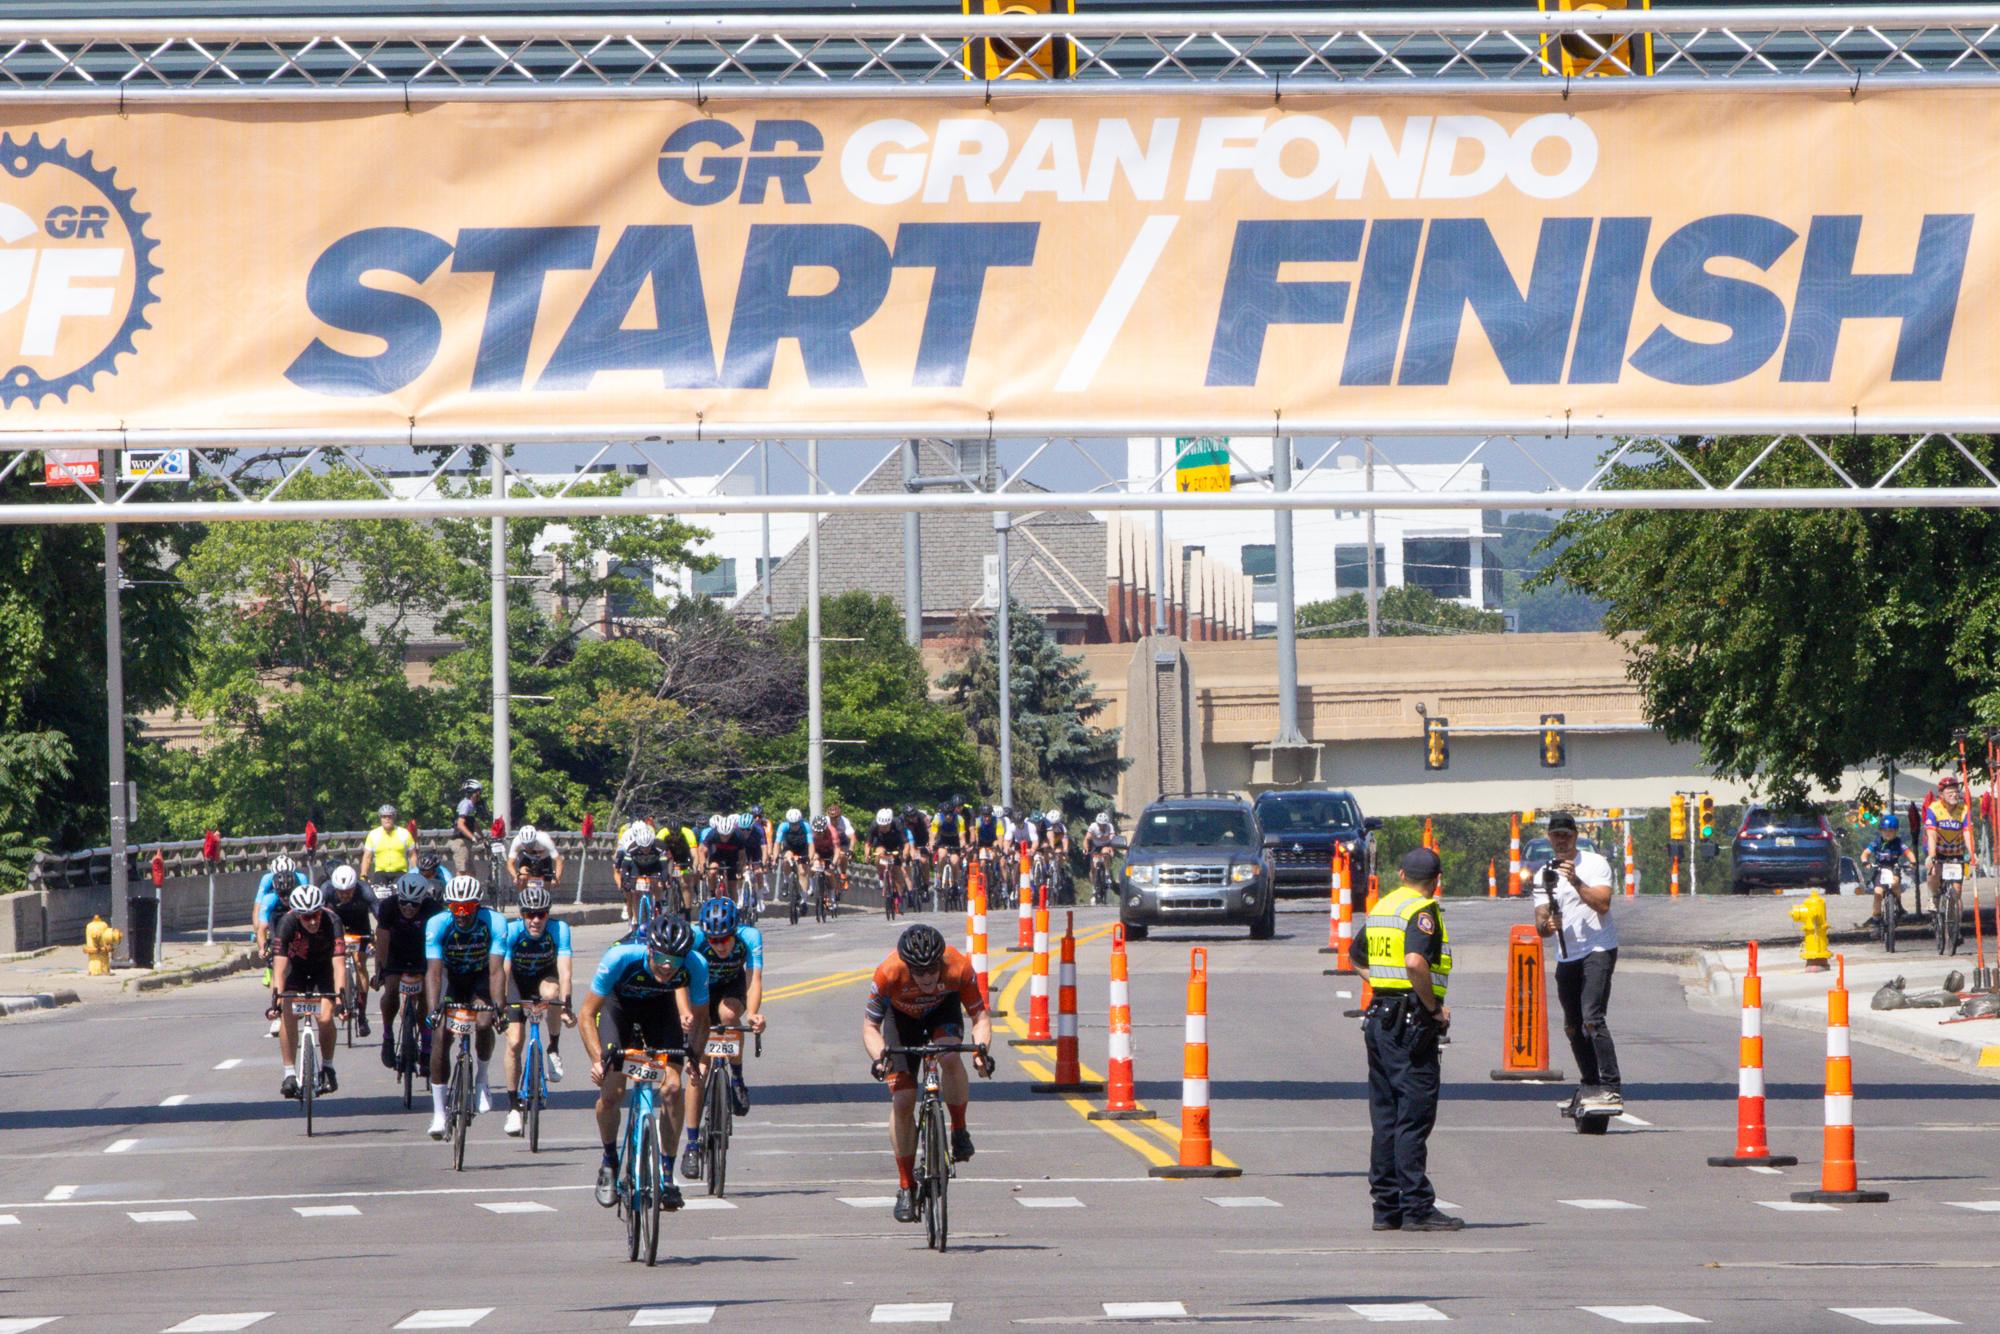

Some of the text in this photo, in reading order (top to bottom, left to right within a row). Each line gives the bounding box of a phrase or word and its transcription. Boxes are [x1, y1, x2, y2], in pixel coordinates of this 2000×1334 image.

[658, 112, 1600, 206] GR GRAN FONDO
[44, 205, 110, 239] GR
[283, 213, 1976, 397] START / FINISH
[1368, 936, 1391, 957] OLICE
[296, 1004, 317, 1013] 2101
[450, 1020, 471, 1032] 2262
[709, 1043, 734, 1054] 2263
[628, 1064, 658, 1079] 2438
